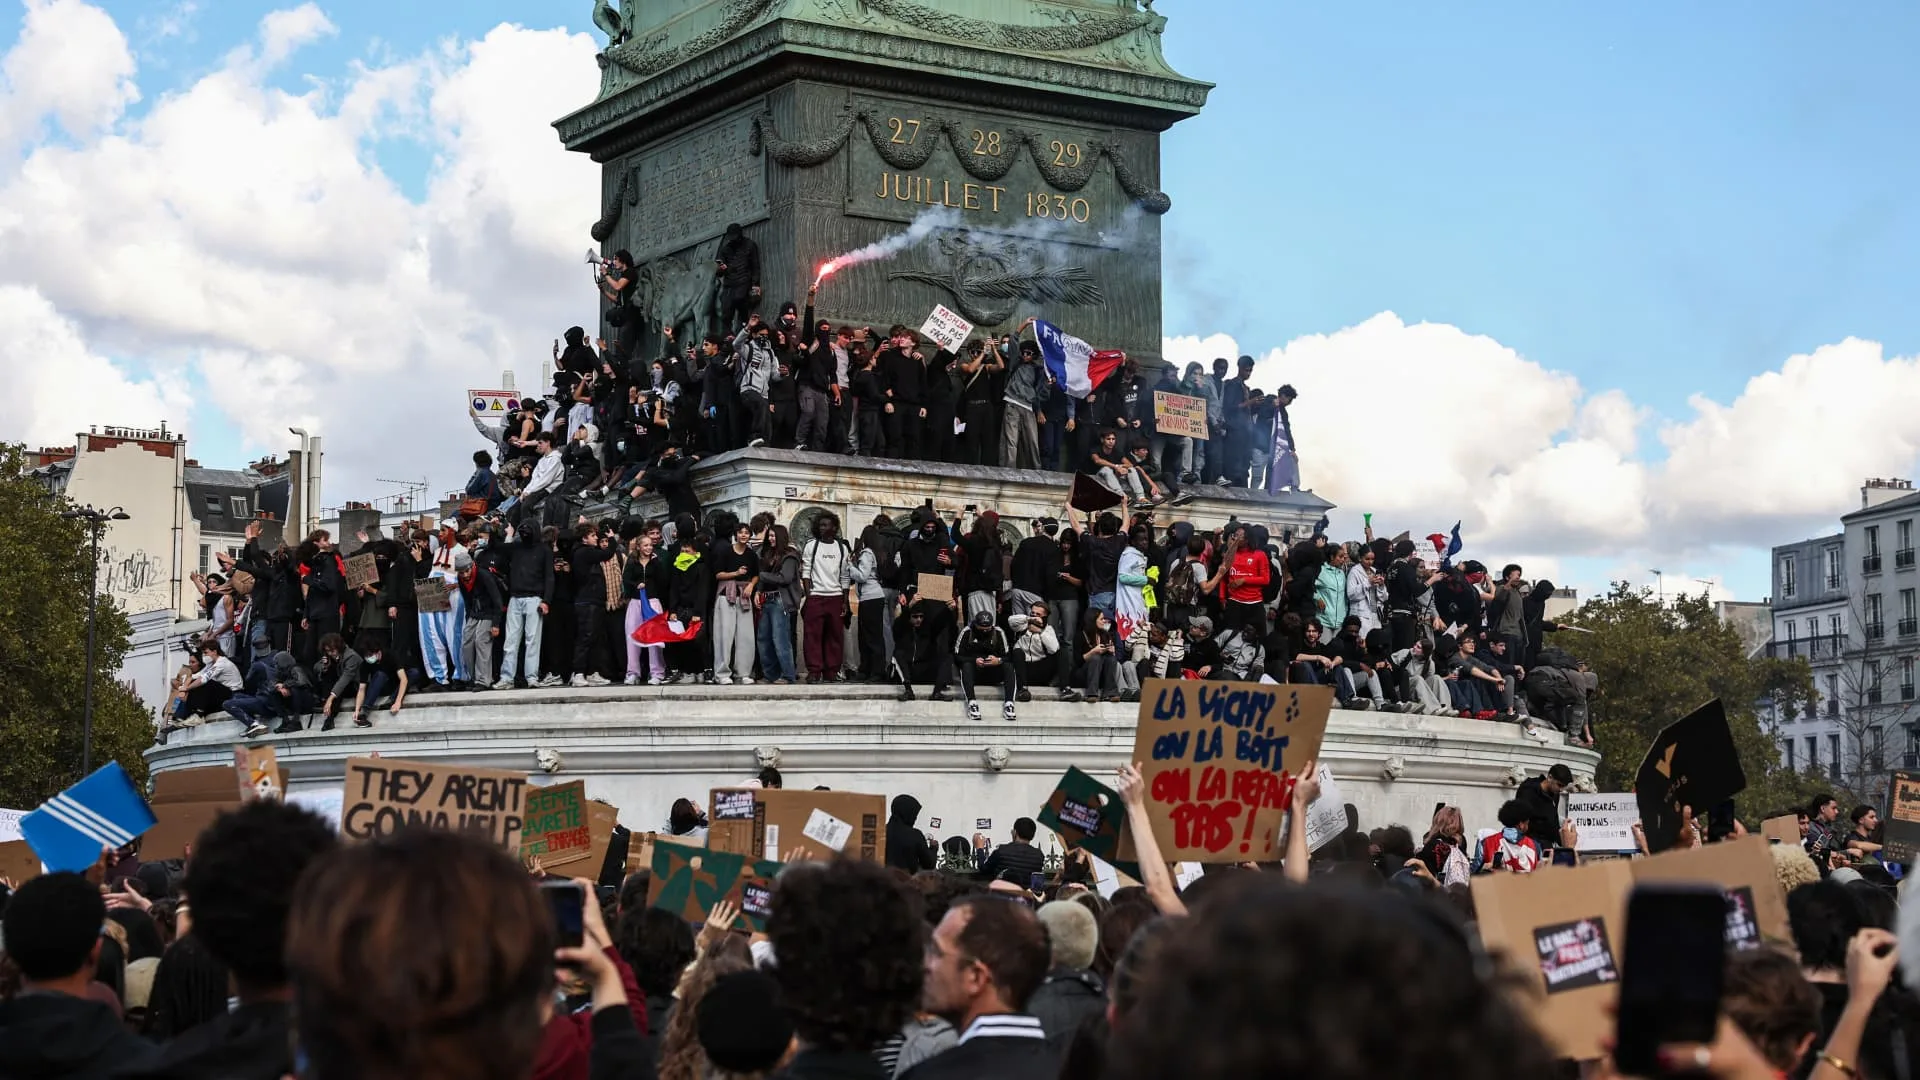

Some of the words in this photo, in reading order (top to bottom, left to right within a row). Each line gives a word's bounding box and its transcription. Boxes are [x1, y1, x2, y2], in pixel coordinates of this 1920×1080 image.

[888, 117, 921, 145] 27
[970, 129, 1001, 157] 28
[1050, 140, 1081, 168] 29
[875, 172, 1006, 213] JUILLET
[1026, 191, 1090, 224] 1830
[949, 328, 964, 340] PAS
[1152, 686, 1187, 721] LA
[1152, 730, 1190, 761] ON
[1193, 725, 1224, 763] LA
[351, 765, 434, 805] THEY
[438, 774, 528, 813] ARENT
[1151, 768, 1191, 805] ON
[1197, 765, 1227, 802] LA
